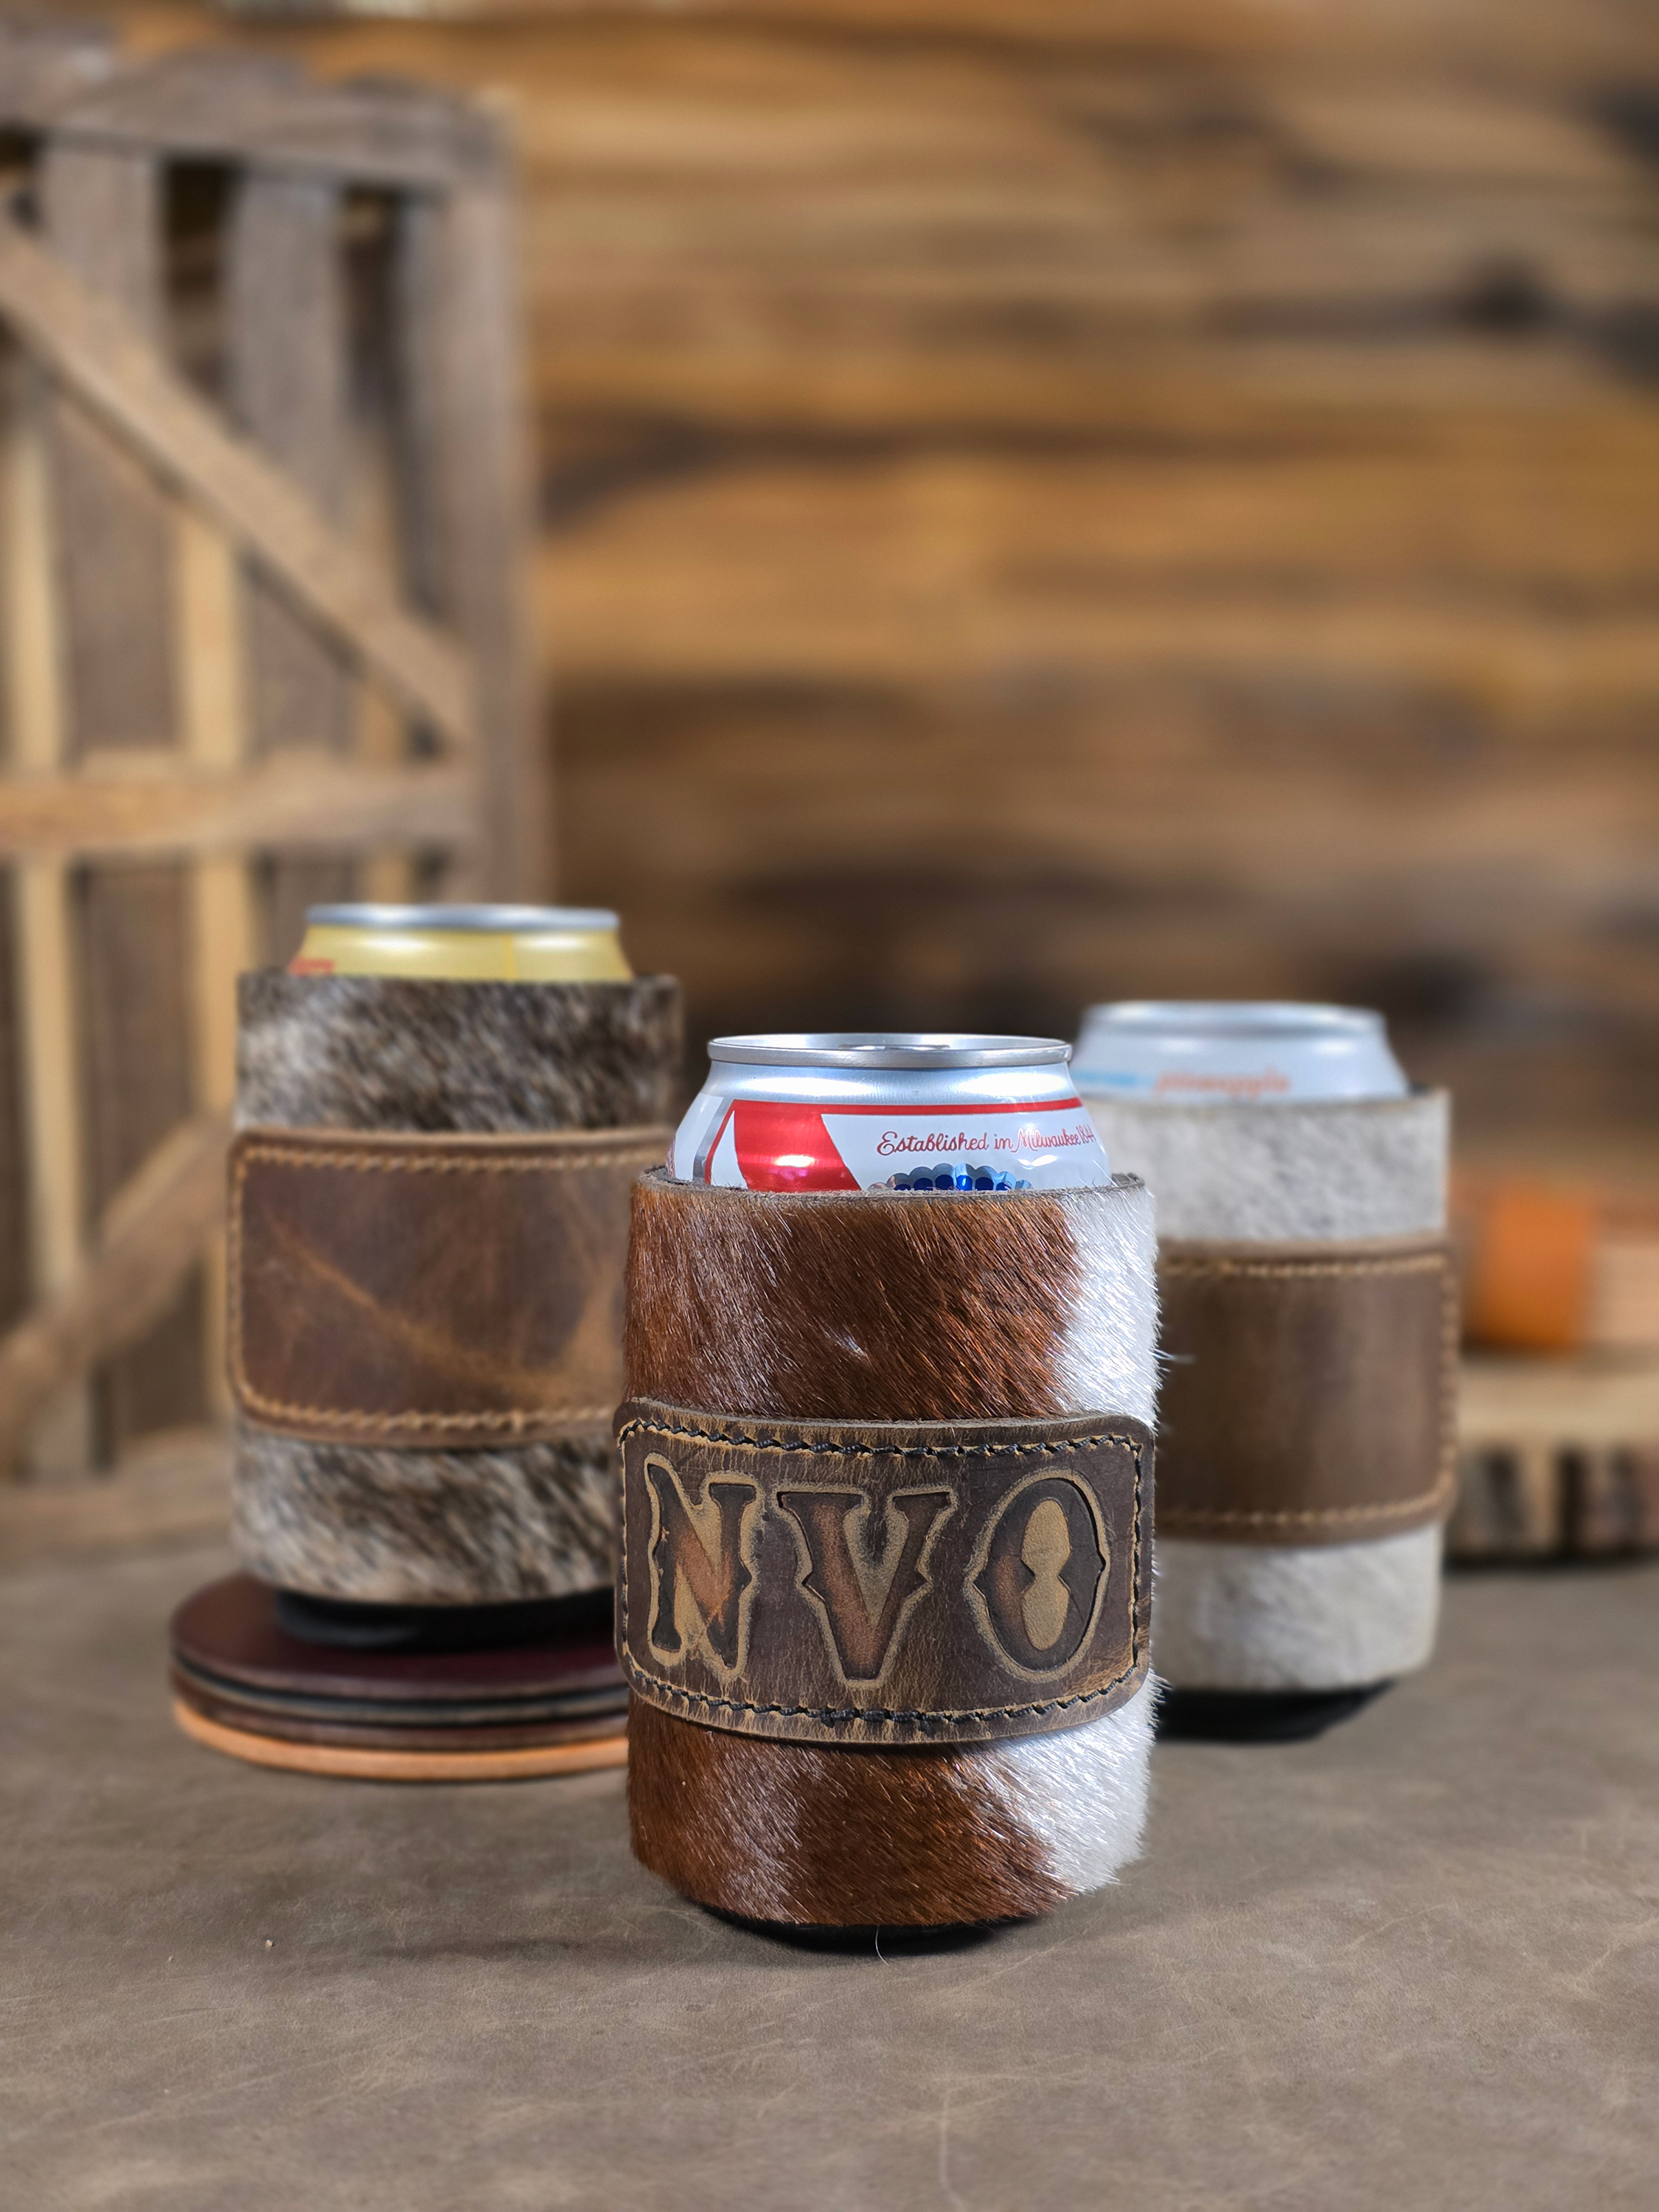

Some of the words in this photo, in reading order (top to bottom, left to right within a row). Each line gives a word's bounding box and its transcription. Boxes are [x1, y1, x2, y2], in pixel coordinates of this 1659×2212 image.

[877, 1130, 989, 1156] Established
[994, 1133, 1013, 1150] in
[1011, 1127, 1081, 1152] Milwaukee
[646, 1451, 1108, 1690] NVO
